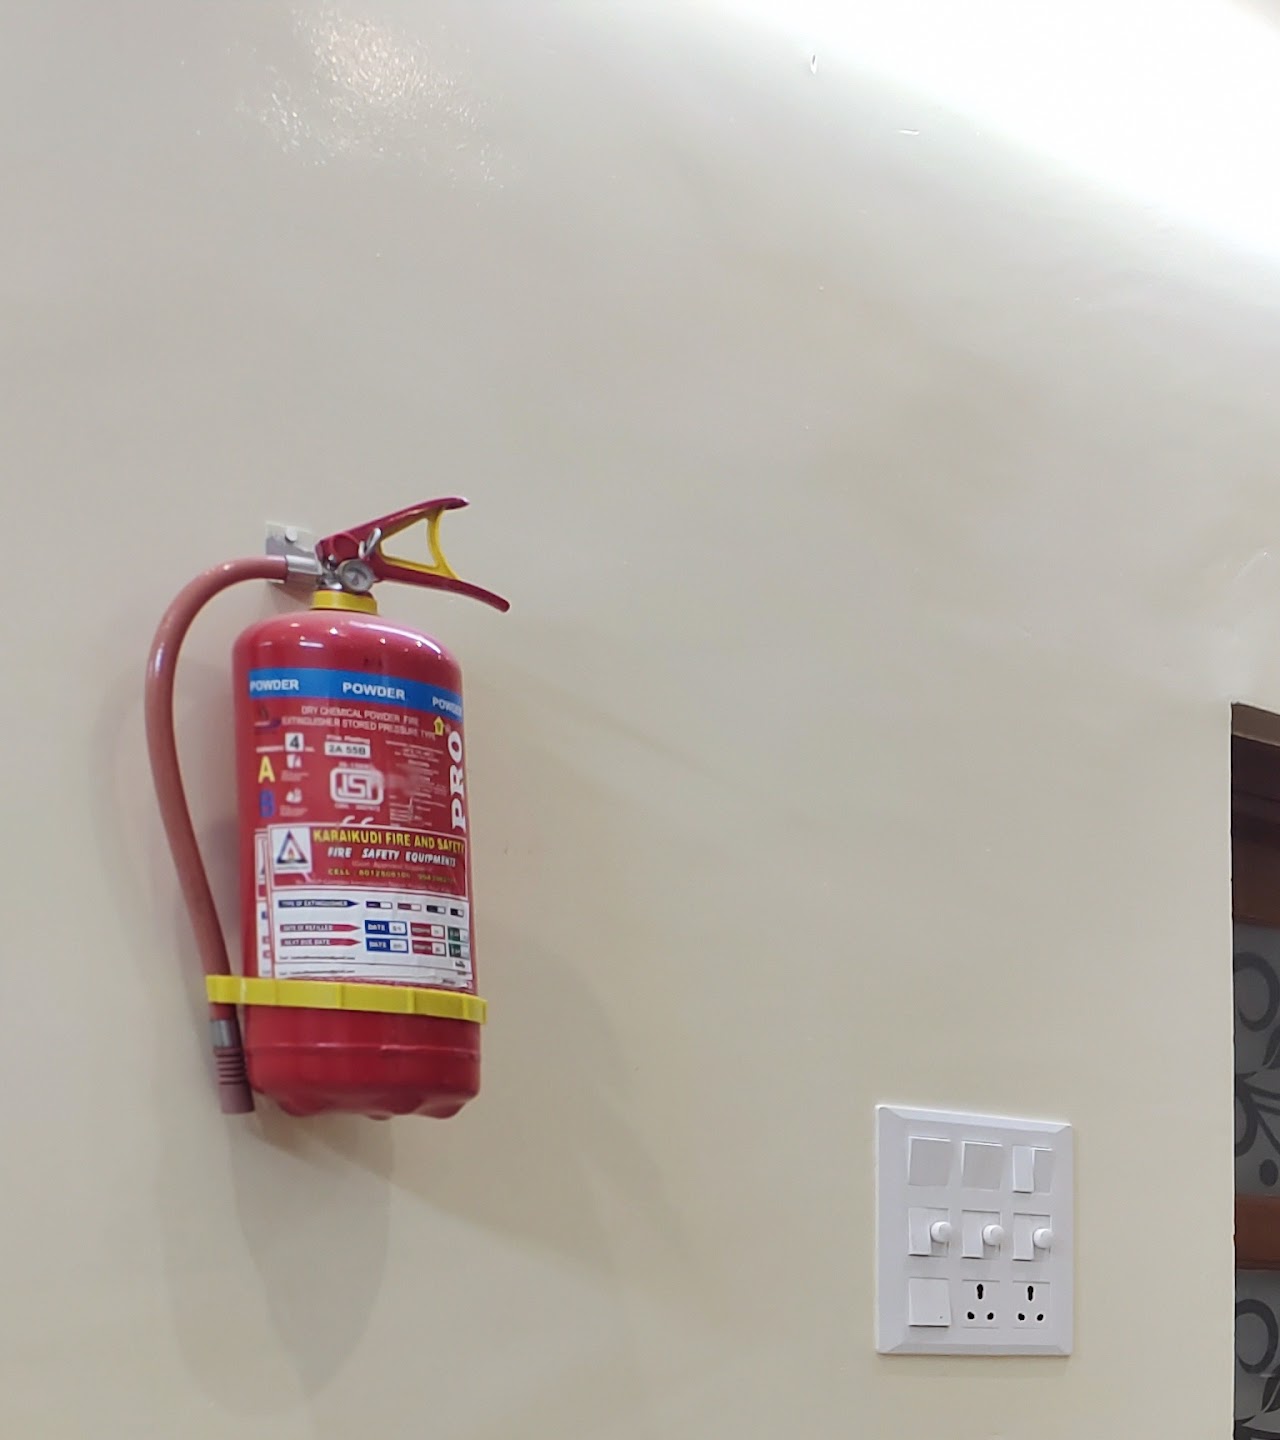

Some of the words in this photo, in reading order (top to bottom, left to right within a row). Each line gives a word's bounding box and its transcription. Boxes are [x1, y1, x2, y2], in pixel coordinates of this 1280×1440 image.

[250, 679, 299, 692] POWDER
[342, 682, 405, 700] POWDER
[301, 706, 318, 715] DRY
[320, 706, 362, 719] CHEMICAL
[364, 710, 400, 723] POWDER
[342, 718, 377, 731] STORED
[378, 722, 418, 737] PRESSURE
[289, 735, 300, 750] 4
[328, 744, 343, 753] 2A
[258, 755, 275, 783] A
[447, 730, 467, 833] PRO
[259, 789, 275, 817] B
[313, 829, 382, 844] KARAIKUDI
[385, 832, 411, 847] FIRE
[414, 837, 435, 849] AND
[327, 847, 352, 858] FIRE
[362, 848, 400, 861] SAFETY
[405, 851, 456, 868] EQUIPMENTS
[328, 868, 350, 876] CELL
[367, 923, 386, 932] DATE
